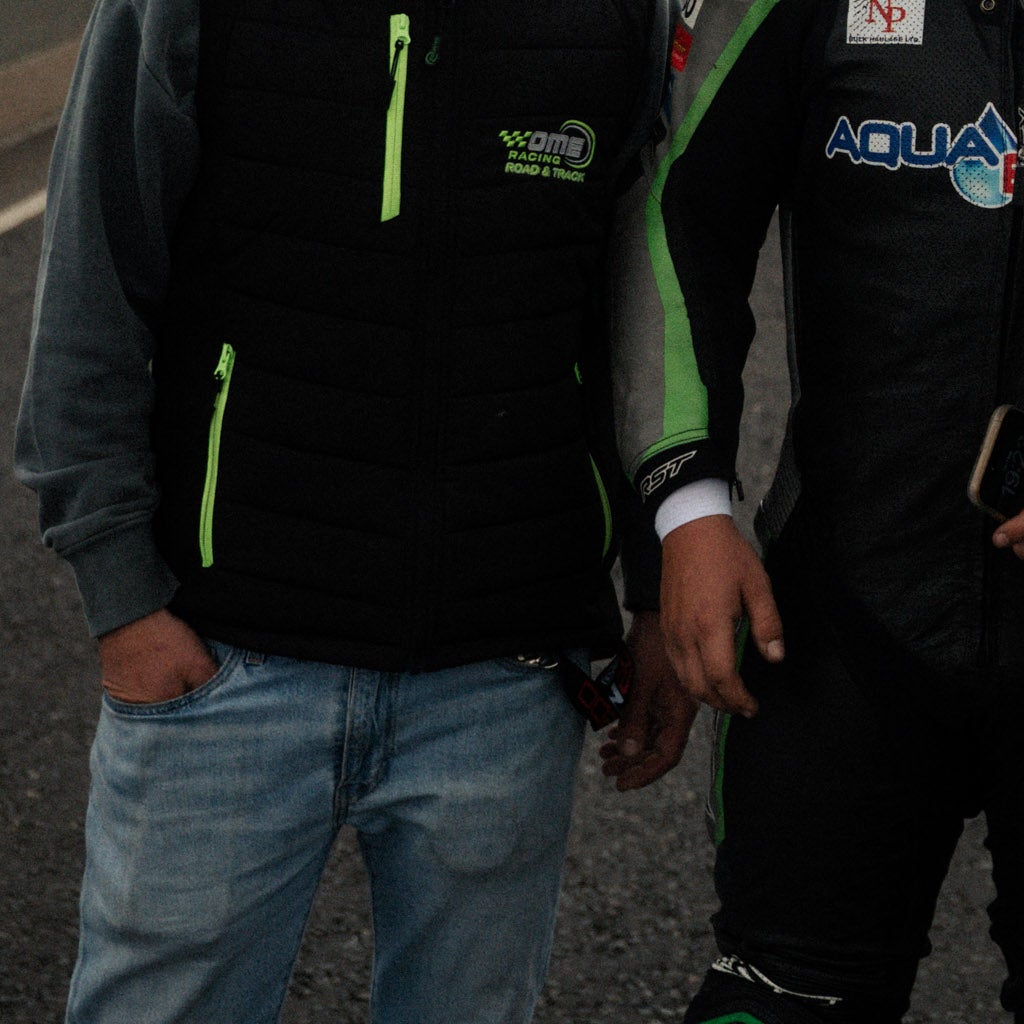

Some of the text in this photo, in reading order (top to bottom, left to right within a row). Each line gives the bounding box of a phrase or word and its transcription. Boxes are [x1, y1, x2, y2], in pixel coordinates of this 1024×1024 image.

[508, 150, 561, 165] RACING
[505, 162, 586, 183] ROAD & TRACK
[640, 449, 698, 504] RST
